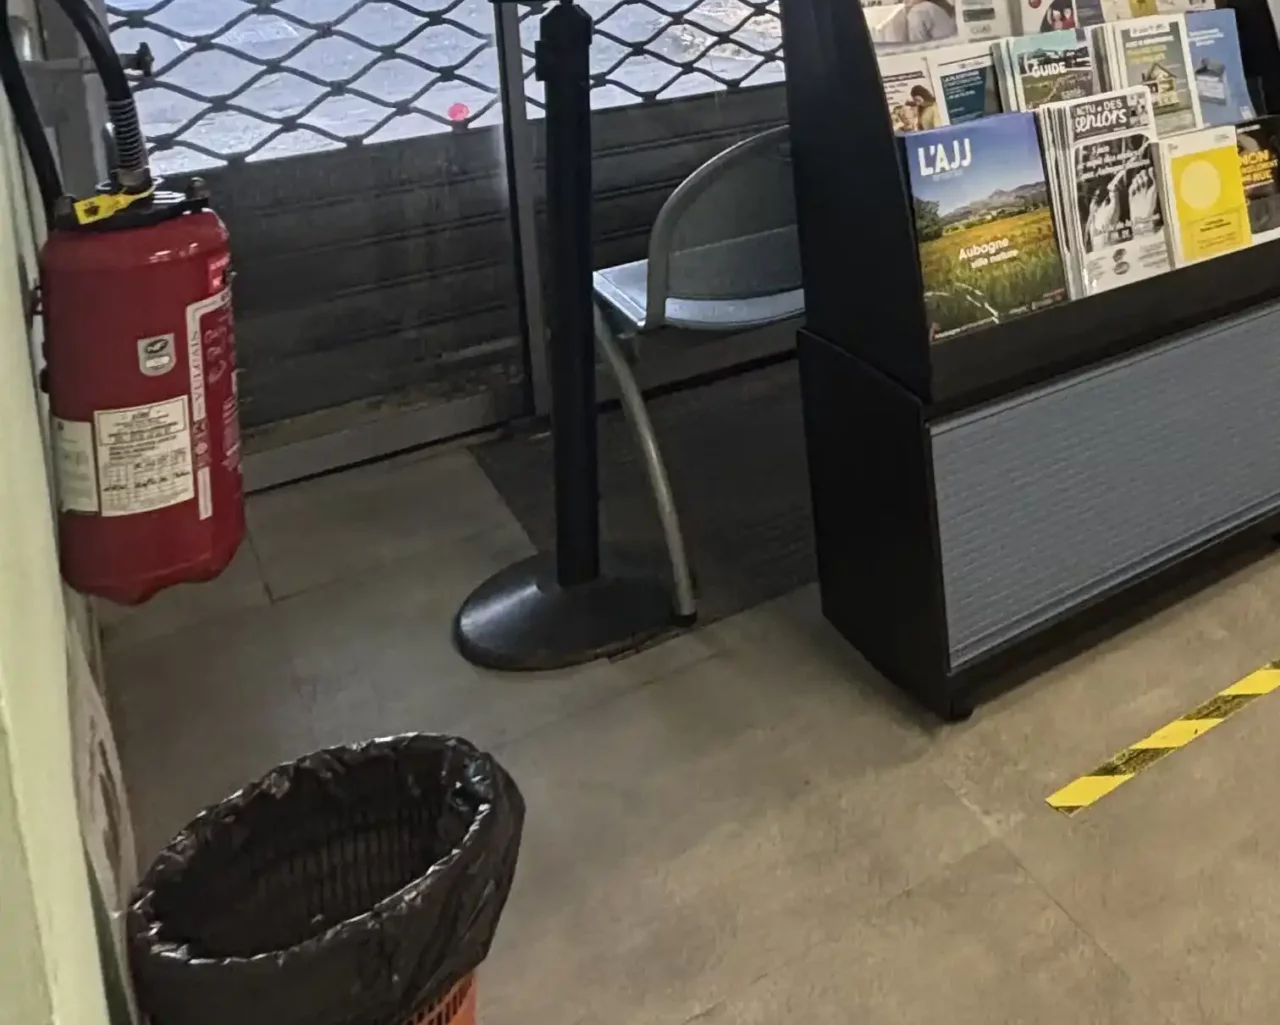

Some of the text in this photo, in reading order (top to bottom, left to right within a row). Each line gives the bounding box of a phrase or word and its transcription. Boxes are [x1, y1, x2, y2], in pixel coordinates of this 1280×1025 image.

[1031, 62, 1067, 78] GUIDE
[1103, 99, 1123, 110] DES
[917, 138, 972, 177] L'AJJ
[958, 237, 1009, 261] Aubagne
